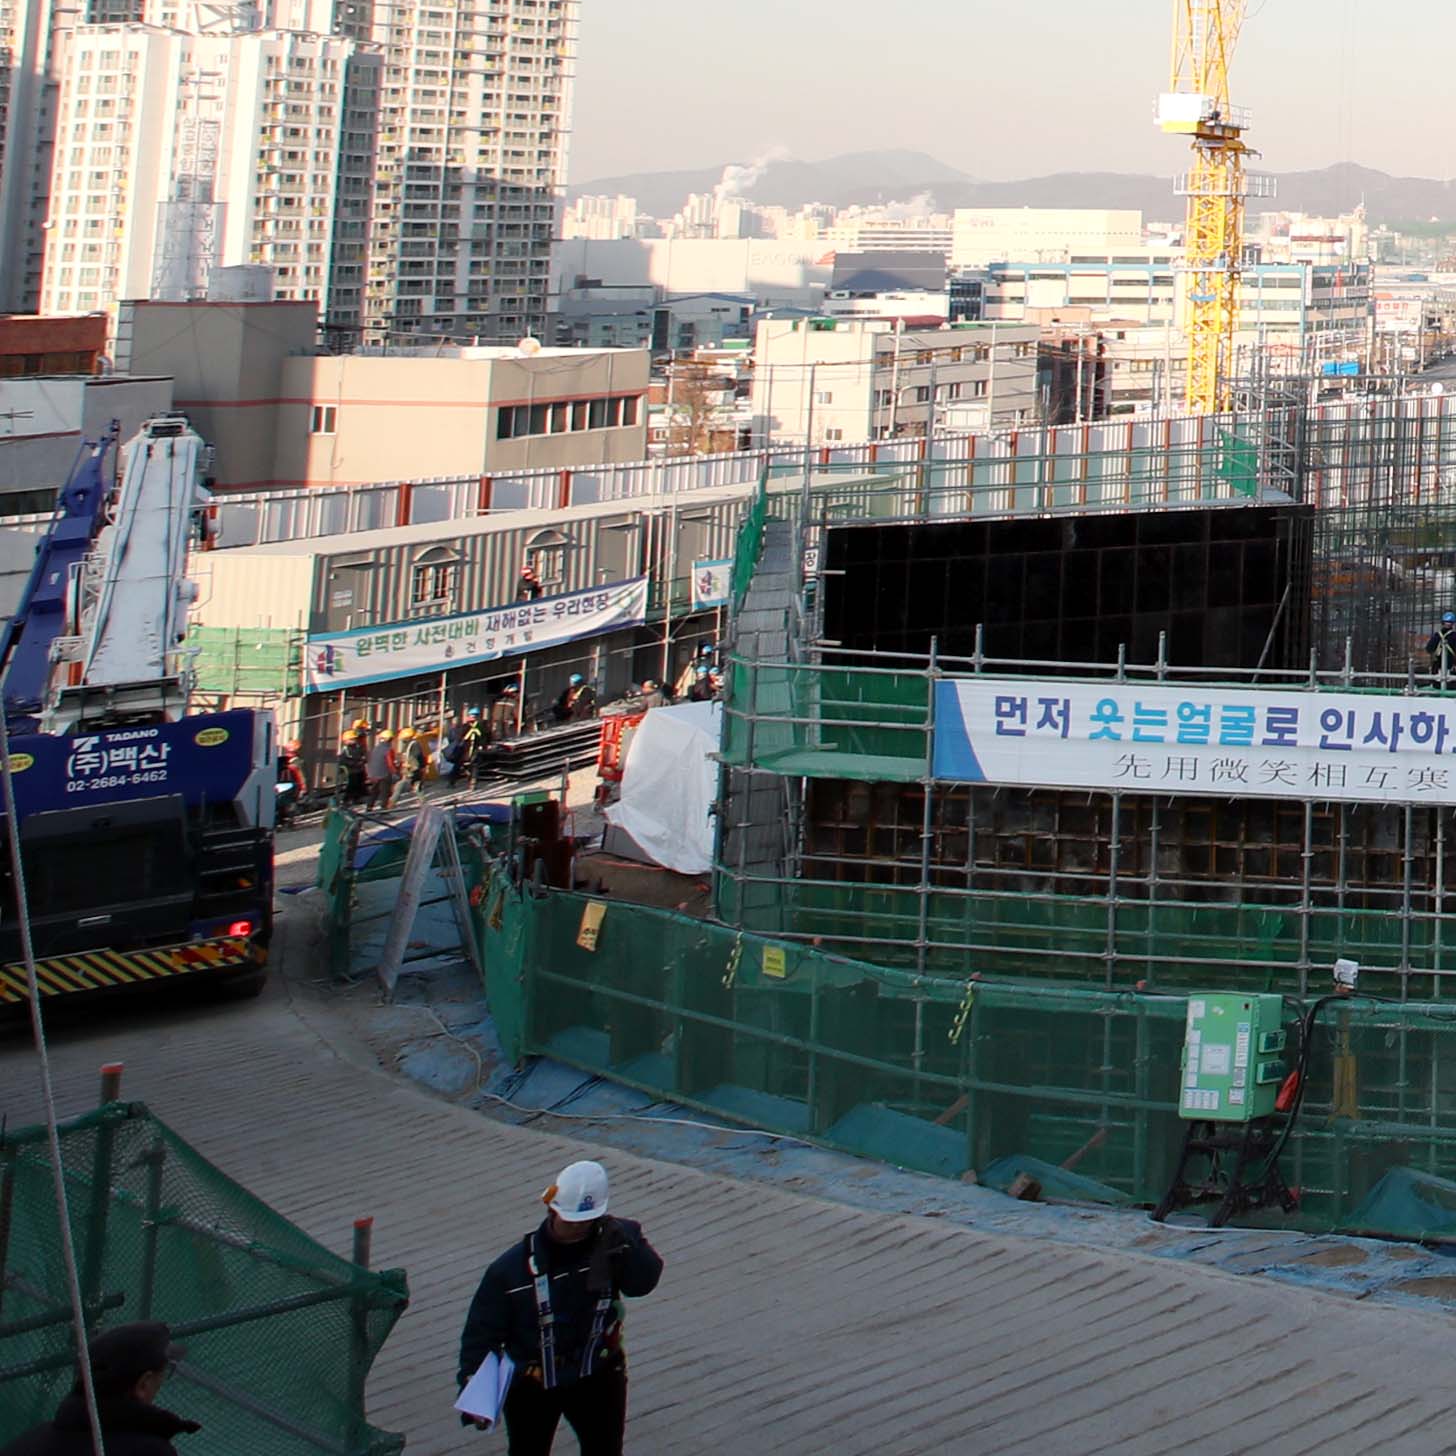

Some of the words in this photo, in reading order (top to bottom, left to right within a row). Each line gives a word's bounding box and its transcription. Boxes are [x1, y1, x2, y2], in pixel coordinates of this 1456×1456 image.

[356, 630, 408, 657] 완벽한
[414, 619, 480, 646] 사전대비
[485, 606, 547, 632] 재해없는
[553, 593, 609, 619] 우리현장
[106, 728, 159, 743] TADANO
[994, 695, 1072, 739] 먼저
[1088, 698, 1300, 747] 웃는얼굴로
[67, 742, 172, 778] (주)백산
[66, 769, 168, 792] 02-2684-6462
